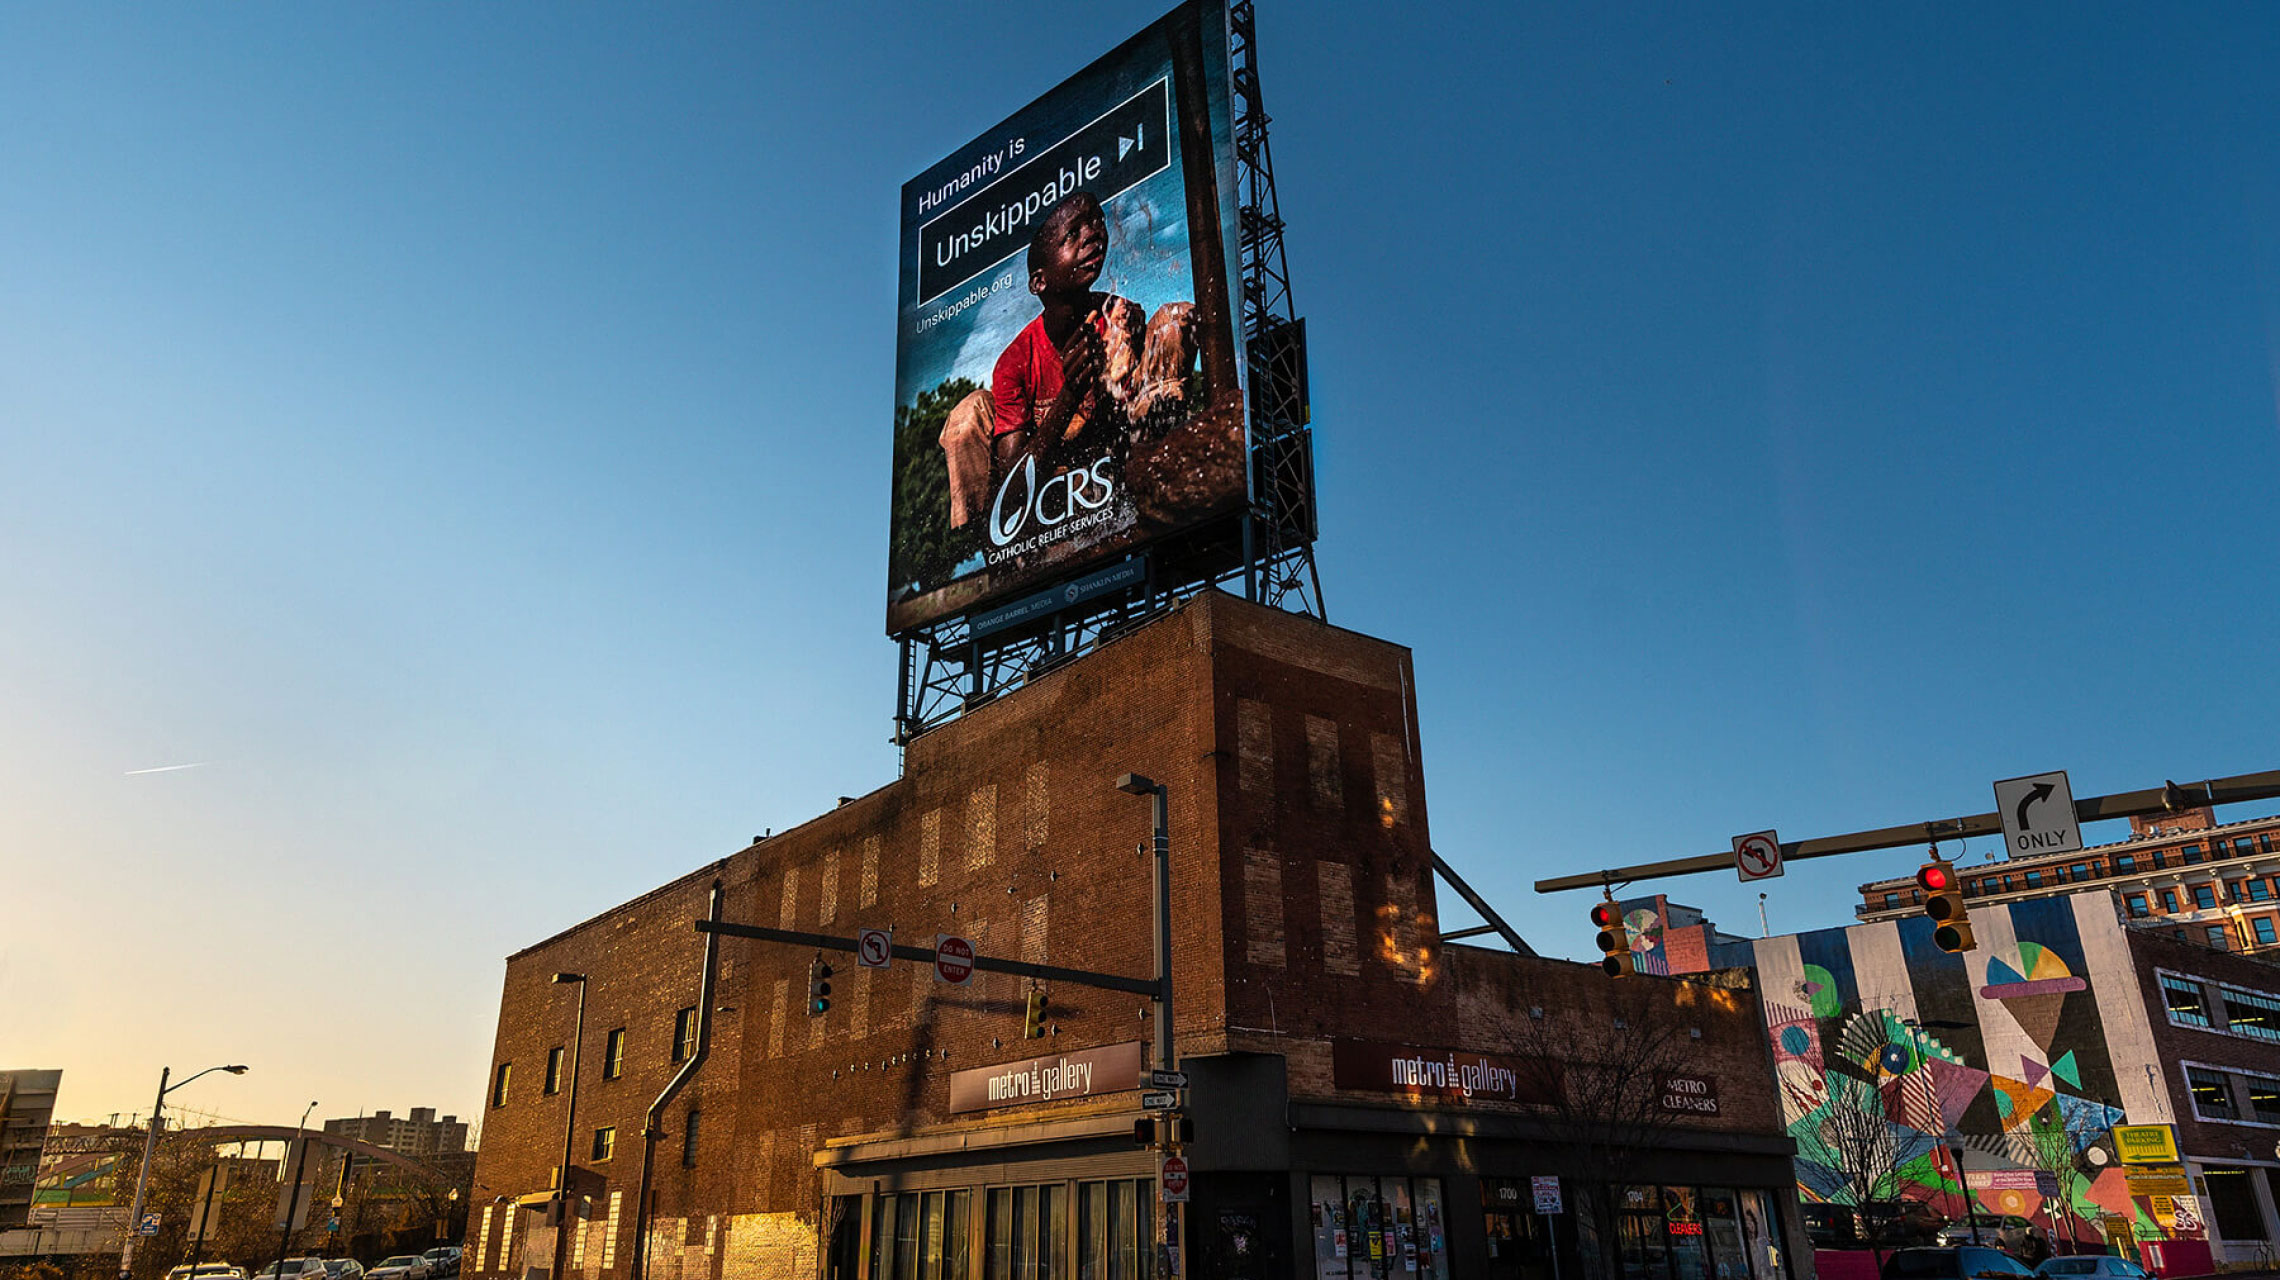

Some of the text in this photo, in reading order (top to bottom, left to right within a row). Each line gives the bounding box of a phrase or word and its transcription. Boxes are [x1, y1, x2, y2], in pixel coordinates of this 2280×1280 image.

[918, 138, 1026, 215] Humanity is
[936, 155, 1102, 268] Unskippable
[916, 271, 1013, 334] Unskippable.org
[1035, 456, 1113, 525] CRS
[988, 508, 1114, 565] CATHOLIC RELIEF SERVICES
[1112, 567, 1135, 582] MEDIA
[977, 598, 1053, 630] ORANGE BARREL MEDIA
[2017, 829, 2066, 850] ONLY
[943, 944, 970, 956] DO NOT
[943, 965, 965, 976] ENTER
[988, 1058, 1093, 1101] metro gallery
[1392, 1055, 1517, 1100] metro gallery
[1666, 1079, 1707, 1095] METRO
[1499, 1187, 1518, 1200] 1700
[1627, 1190, 1643, 1202] 1704
[1668, 1221, 1703, 1236] CLEANERS
